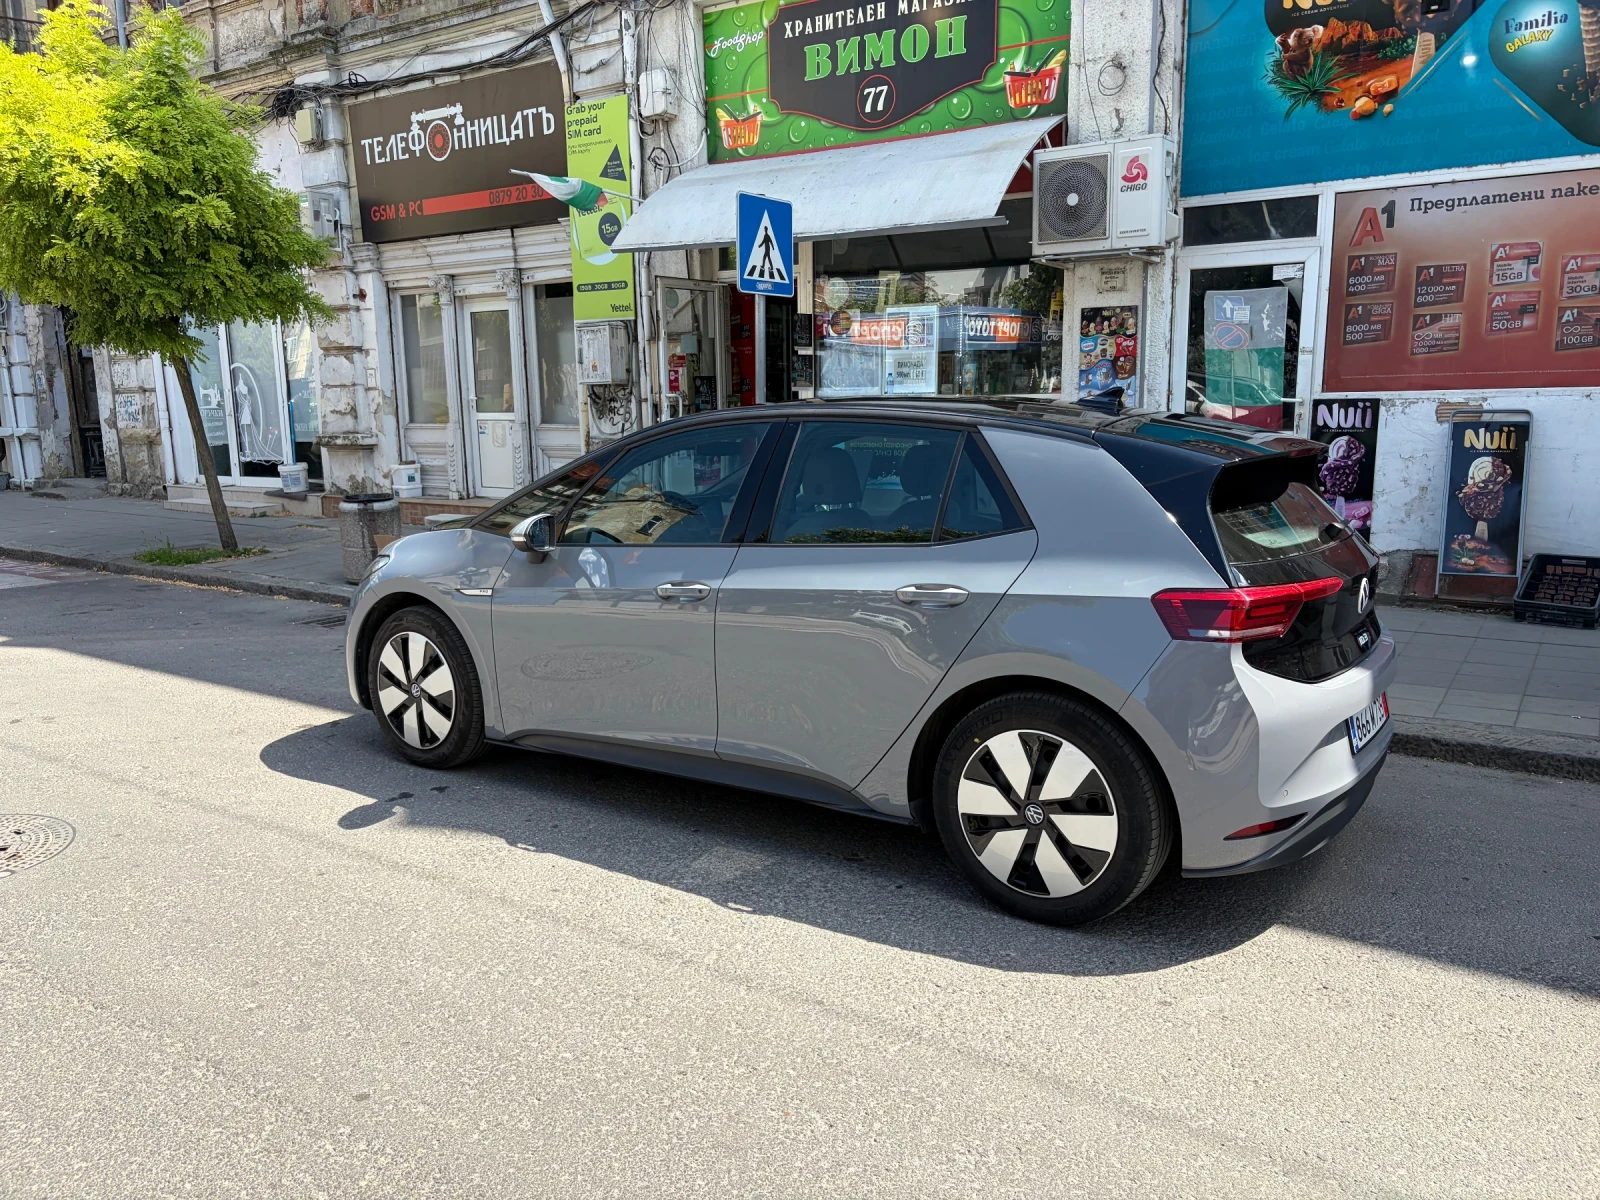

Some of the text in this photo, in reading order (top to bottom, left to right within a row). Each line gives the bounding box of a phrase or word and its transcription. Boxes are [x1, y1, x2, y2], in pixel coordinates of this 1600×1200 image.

[783, 0, 974, 39] ХРАНИТЕЛЕН МАГА
[1503, 10, 1569, 35] Familia
[804, 15, 968, 82] ВИМОН
[1505, 29, 1554, 53] GALAXY
[863, 85, 889, 113] 77
[566, 101, 606, 115] Grab your
[567, 113, 598, 130] prepaid
[567, 124, 602, 140] SIM card
[488, 185, 545, 205] 0879 20 30
[1120, 182, 1148, 193] CHIGO
[1409, 188, 1545, 215] Предплатени
[370, 200, 422, 222] GSM & PC
[1349, 199, 1397, 247] A1
[1494, 246, 1510, 260] A1
[1350, 256, 1366, 272] A1
[1442, 265, 1465, 273] ULTRA
[1565, 257, 1582, 272] A1
[1348, 275, 1372, 285] 6000
[1419, 267, 1435, 282] A1
[1496, 271, 1523, 282] 15GB
[1348, 285, 1366, 293] 400
[1566, 284, 1598, 295] 30GB
[1416, 294, 1435, 303] 600
[1491, 294, 1507, 308] A1
[1347, 305, 1363, 320] A1
[1561, 308, 1578, 322] A1
[1346, 323, 1370, 333] 8000
[1415, 315, 1431, 329] A1
[1492, 320, 1522, 330] 50GB
[1345, 332, 1364, 341] 500
[1562, 335, 1593, 344] 100 GB
[1316, 401, 1373, 429] Nuii
[1463, 426, 1517, 450] Nuii
